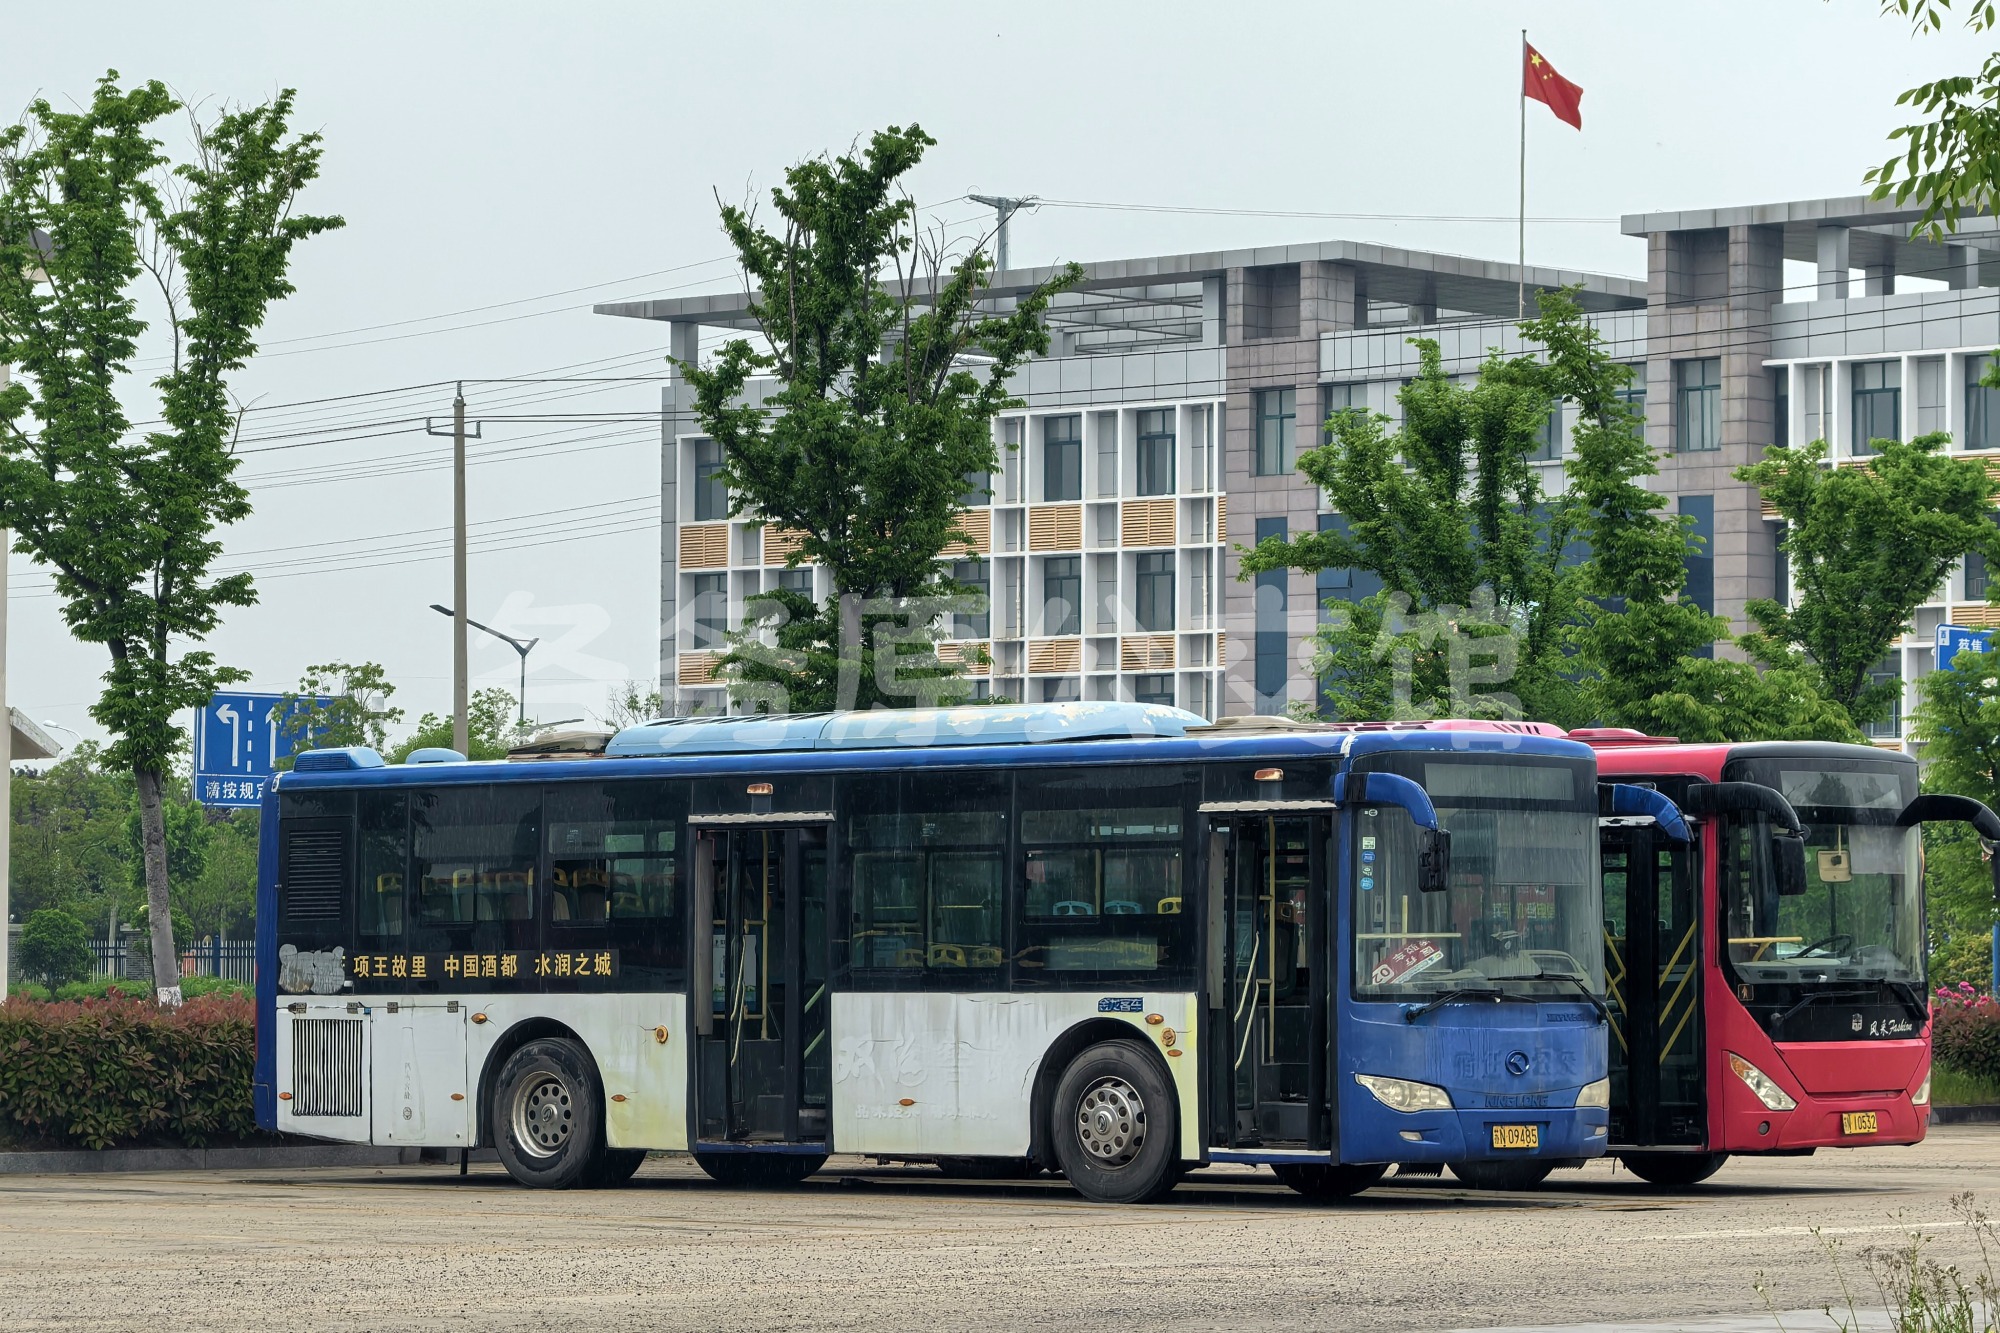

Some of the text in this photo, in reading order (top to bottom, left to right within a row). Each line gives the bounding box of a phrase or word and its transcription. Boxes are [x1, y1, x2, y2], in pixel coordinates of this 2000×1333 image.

[353, 955, 427, 978] 项王故里
[444, 954, 518, 978] 中国酒都
[534, 952, 612, 976] 水润之城
[1888, 1018, 1913, 1035] Fashion
